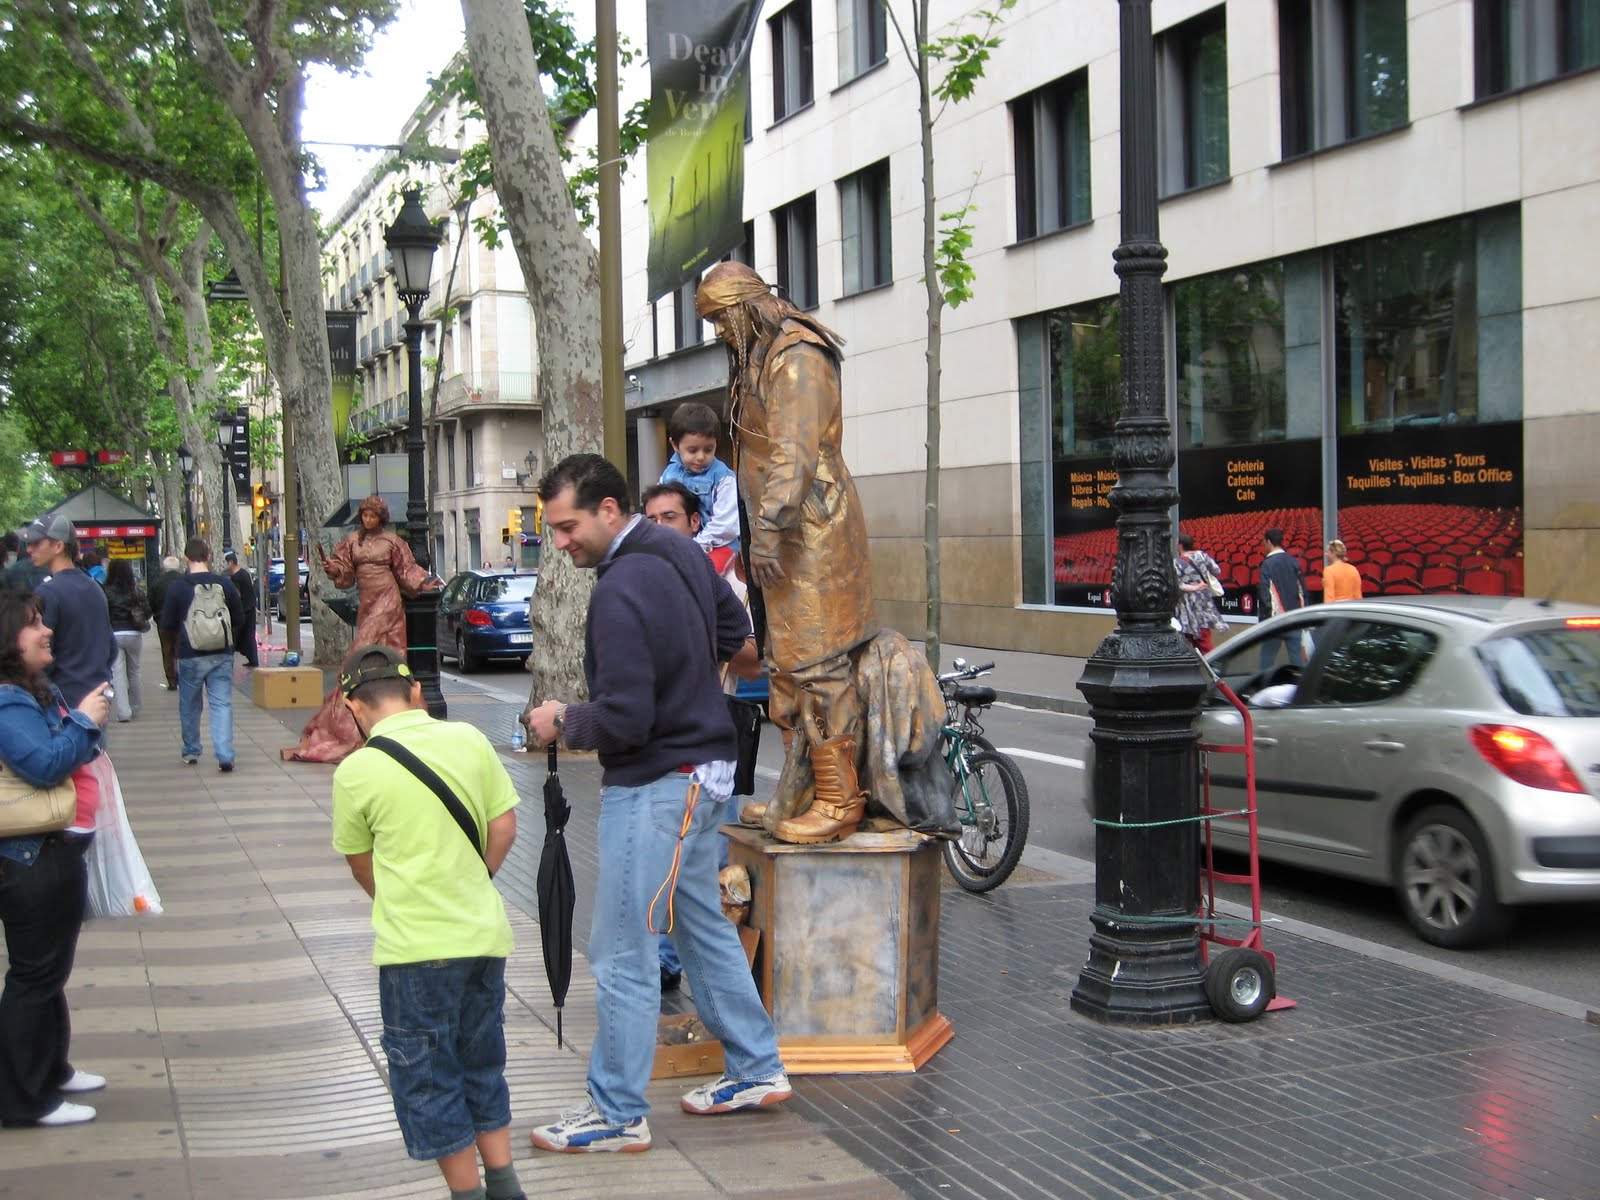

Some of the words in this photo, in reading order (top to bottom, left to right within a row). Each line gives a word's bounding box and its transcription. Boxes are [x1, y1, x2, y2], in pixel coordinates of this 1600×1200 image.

[664, 88, 719, 120] Ven
[1369, 459, 1404, 472] Visites
[1411, 456, 1447, 470] Visitas
[1454, 454, 1486, 467] Tours
[1097, 483, 1113, 494] Libr
[1347, 475, 1391, 490] Taquilles
[1398, 472, 1446, 488] Taquillas
[1453, 470, 1475, 484] Box
[1478, 469, 1513, 483] Office
[1097, 495, 1111, 508] Reg
